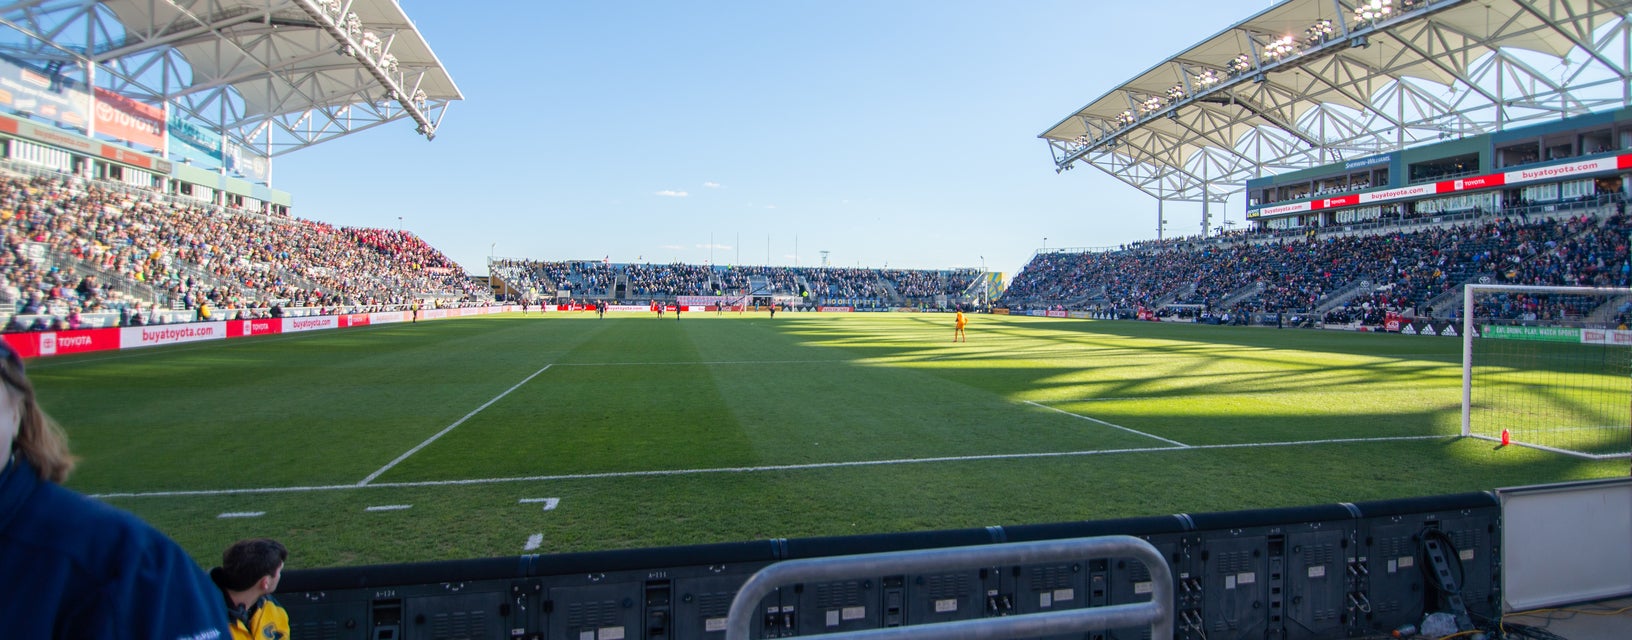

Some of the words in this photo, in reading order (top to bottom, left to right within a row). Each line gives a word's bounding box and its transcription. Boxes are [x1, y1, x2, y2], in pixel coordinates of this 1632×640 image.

[113, 109, 161, 135] TOYOTA
[1522, 161, 1598, 179] buyatoyota.com
[1464, 179, 1485, 187] TOYOTA
[1371, 187, 1424, 200] buyatoyota.com
[1331, 198, 1346, 206] TOYOTA
[1264, 204, 1303, 215] buyatoyota.com
[252, 323, 269, 331] TOYOTA
[293, 318, 331, 329] buyatoyota.com
[142, 326, 213, 343] buyatoyota.com
[58, 335, 92, 347] TOYOTA
